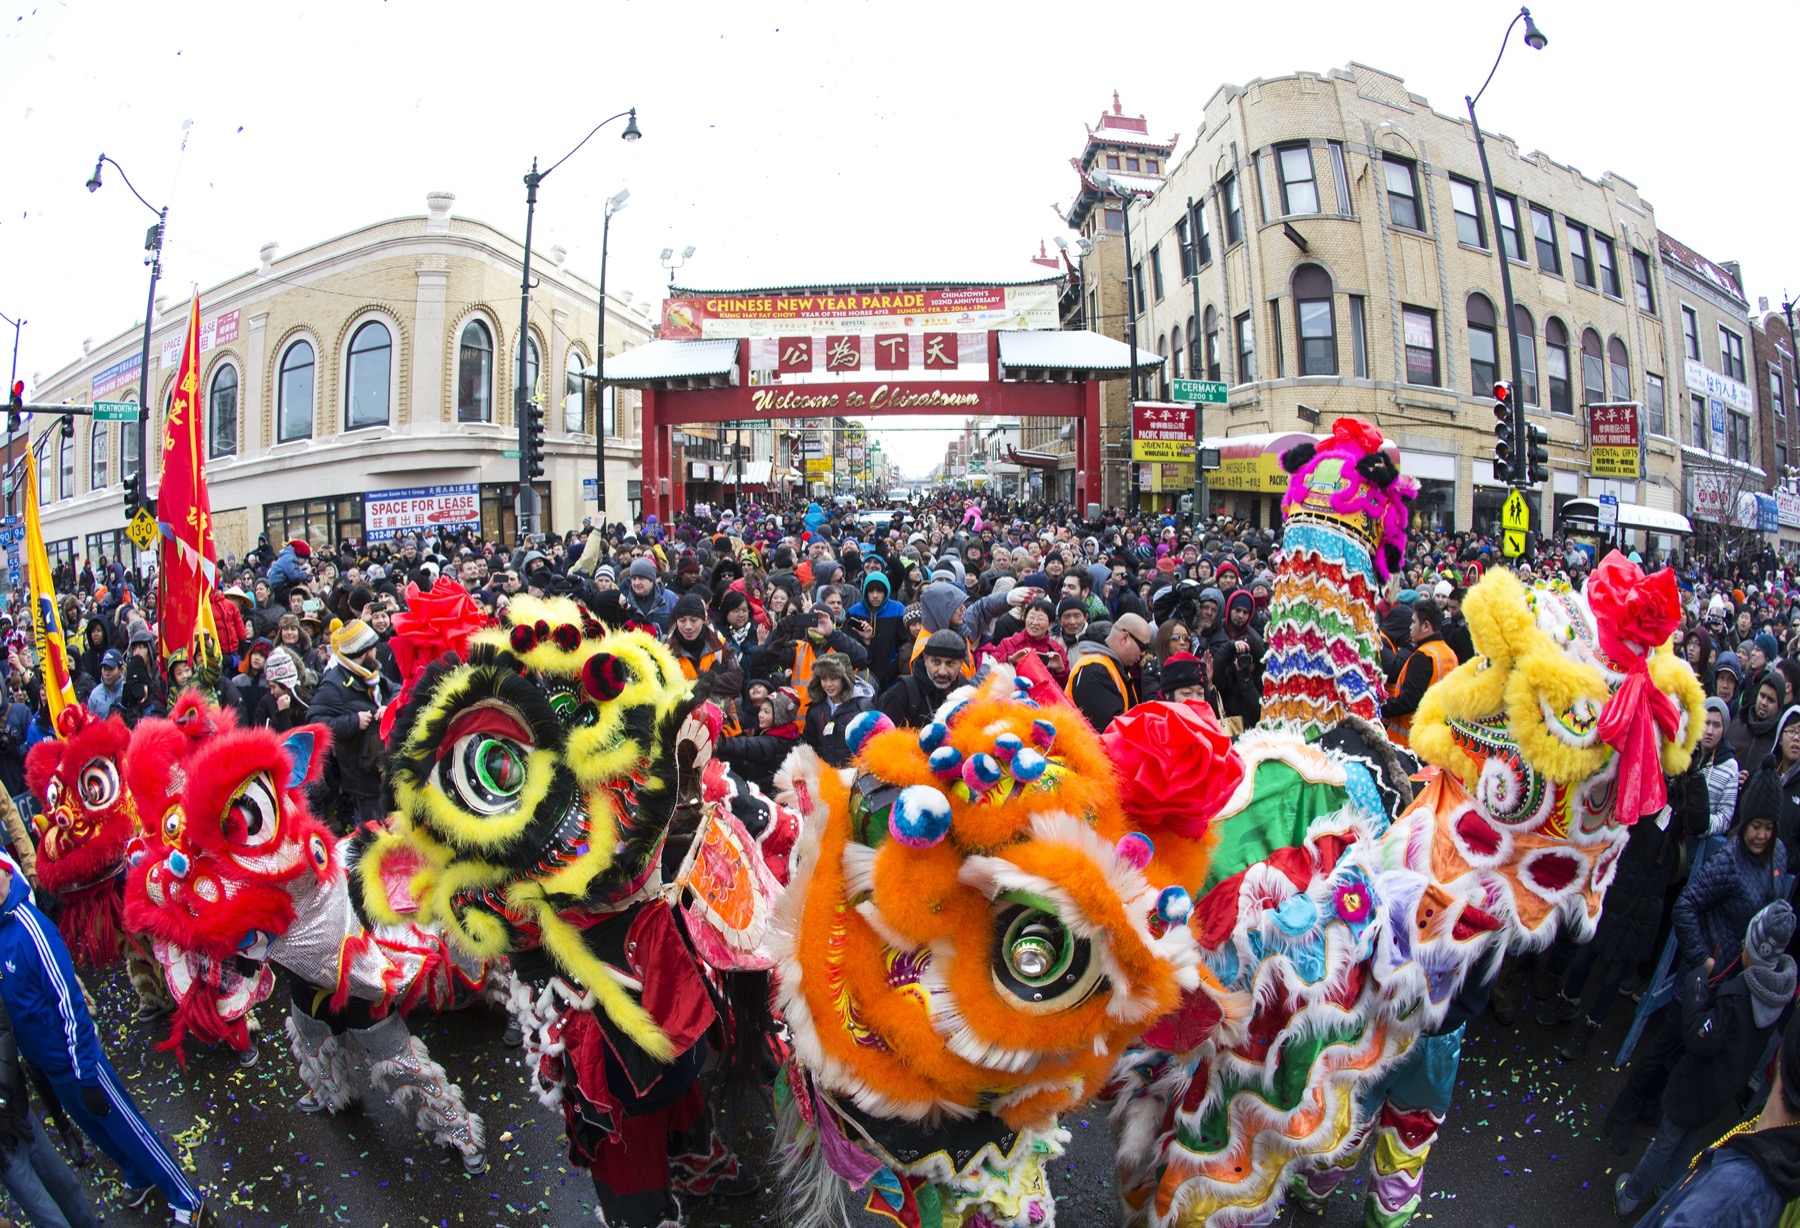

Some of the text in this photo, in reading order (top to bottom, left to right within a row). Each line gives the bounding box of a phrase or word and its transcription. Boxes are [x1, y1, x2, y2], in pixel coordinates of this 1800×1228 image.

[941, 290, 989, 299] CHINATOWN'S
[706, 294, 925, 312] CHINESE NEW YEAR PARADE
[953, 297, 1000, 305] ANNIVERSARY
[163, 320, 216, 353] SPACE EASE
[1181, 382, 1217, 393] CERMAK
[752, 384, 980, 412] Welcome to Chinatown
[98, 404, 132, 412] WENTWORTH
[1143, 409, 1190, 422] 太平洋
[1594, 408, 1634, 423] 太平洋
[1138, 430, 1158, 439] PACIFIC
[1159, 431, 1187, 440] FURNITURE
[1593, 434, 1607, 444] PACIFIC
[1608, 434, 1631, 444] FURNITURE
[1592, 448, 1638, 458] ORIENTAL GIFTS
[1269, 475, 1288, 486] PACIFIC
[371, 496, 474, 516] SPACE FOR LEASE
[14, 527, 24, 536] 94
[9, 558, 19, 568] 55
